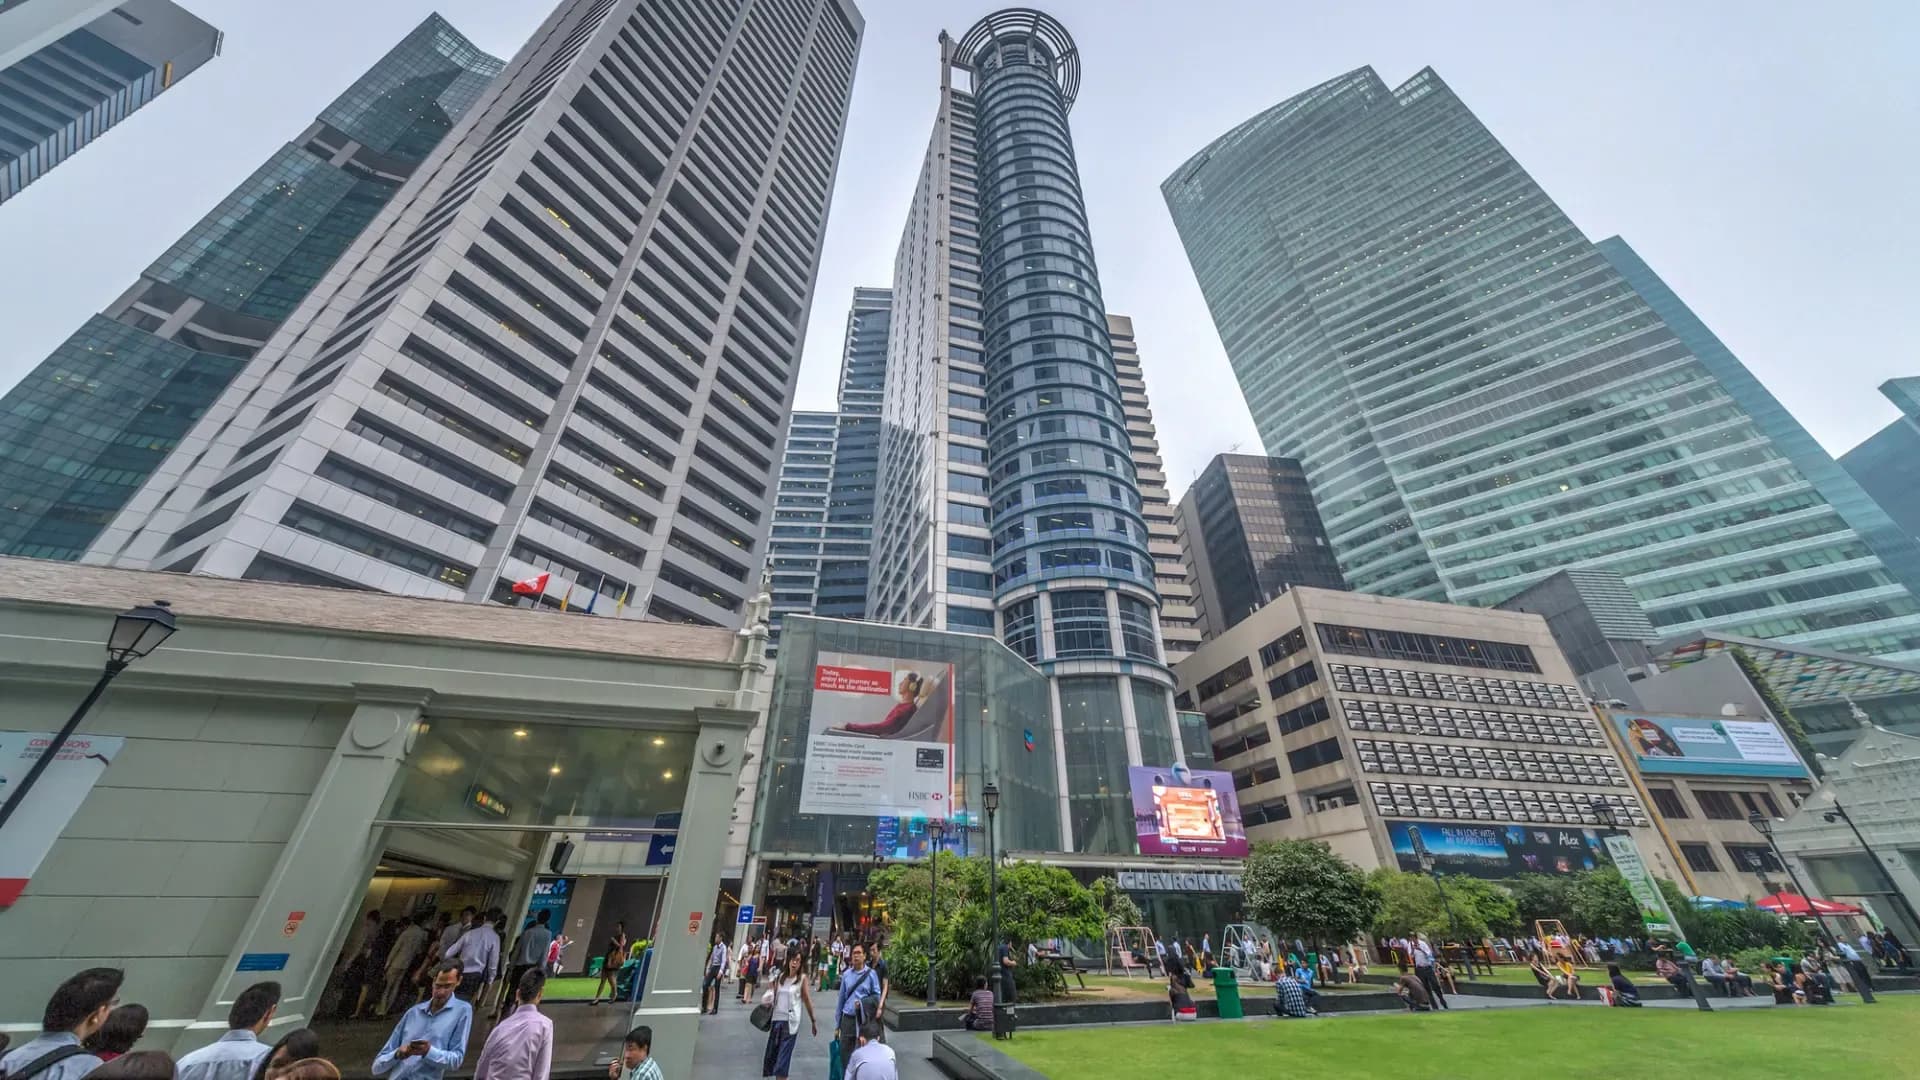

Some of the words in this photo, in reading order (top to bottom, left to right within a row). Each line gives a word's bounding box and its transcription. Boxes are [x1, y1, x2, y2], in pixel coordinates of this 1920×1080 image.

[838, 676, 848, 684] the
[908, 791, 930, 801] HSBC
[1120, 871, 1209, 890] CHEVRON
